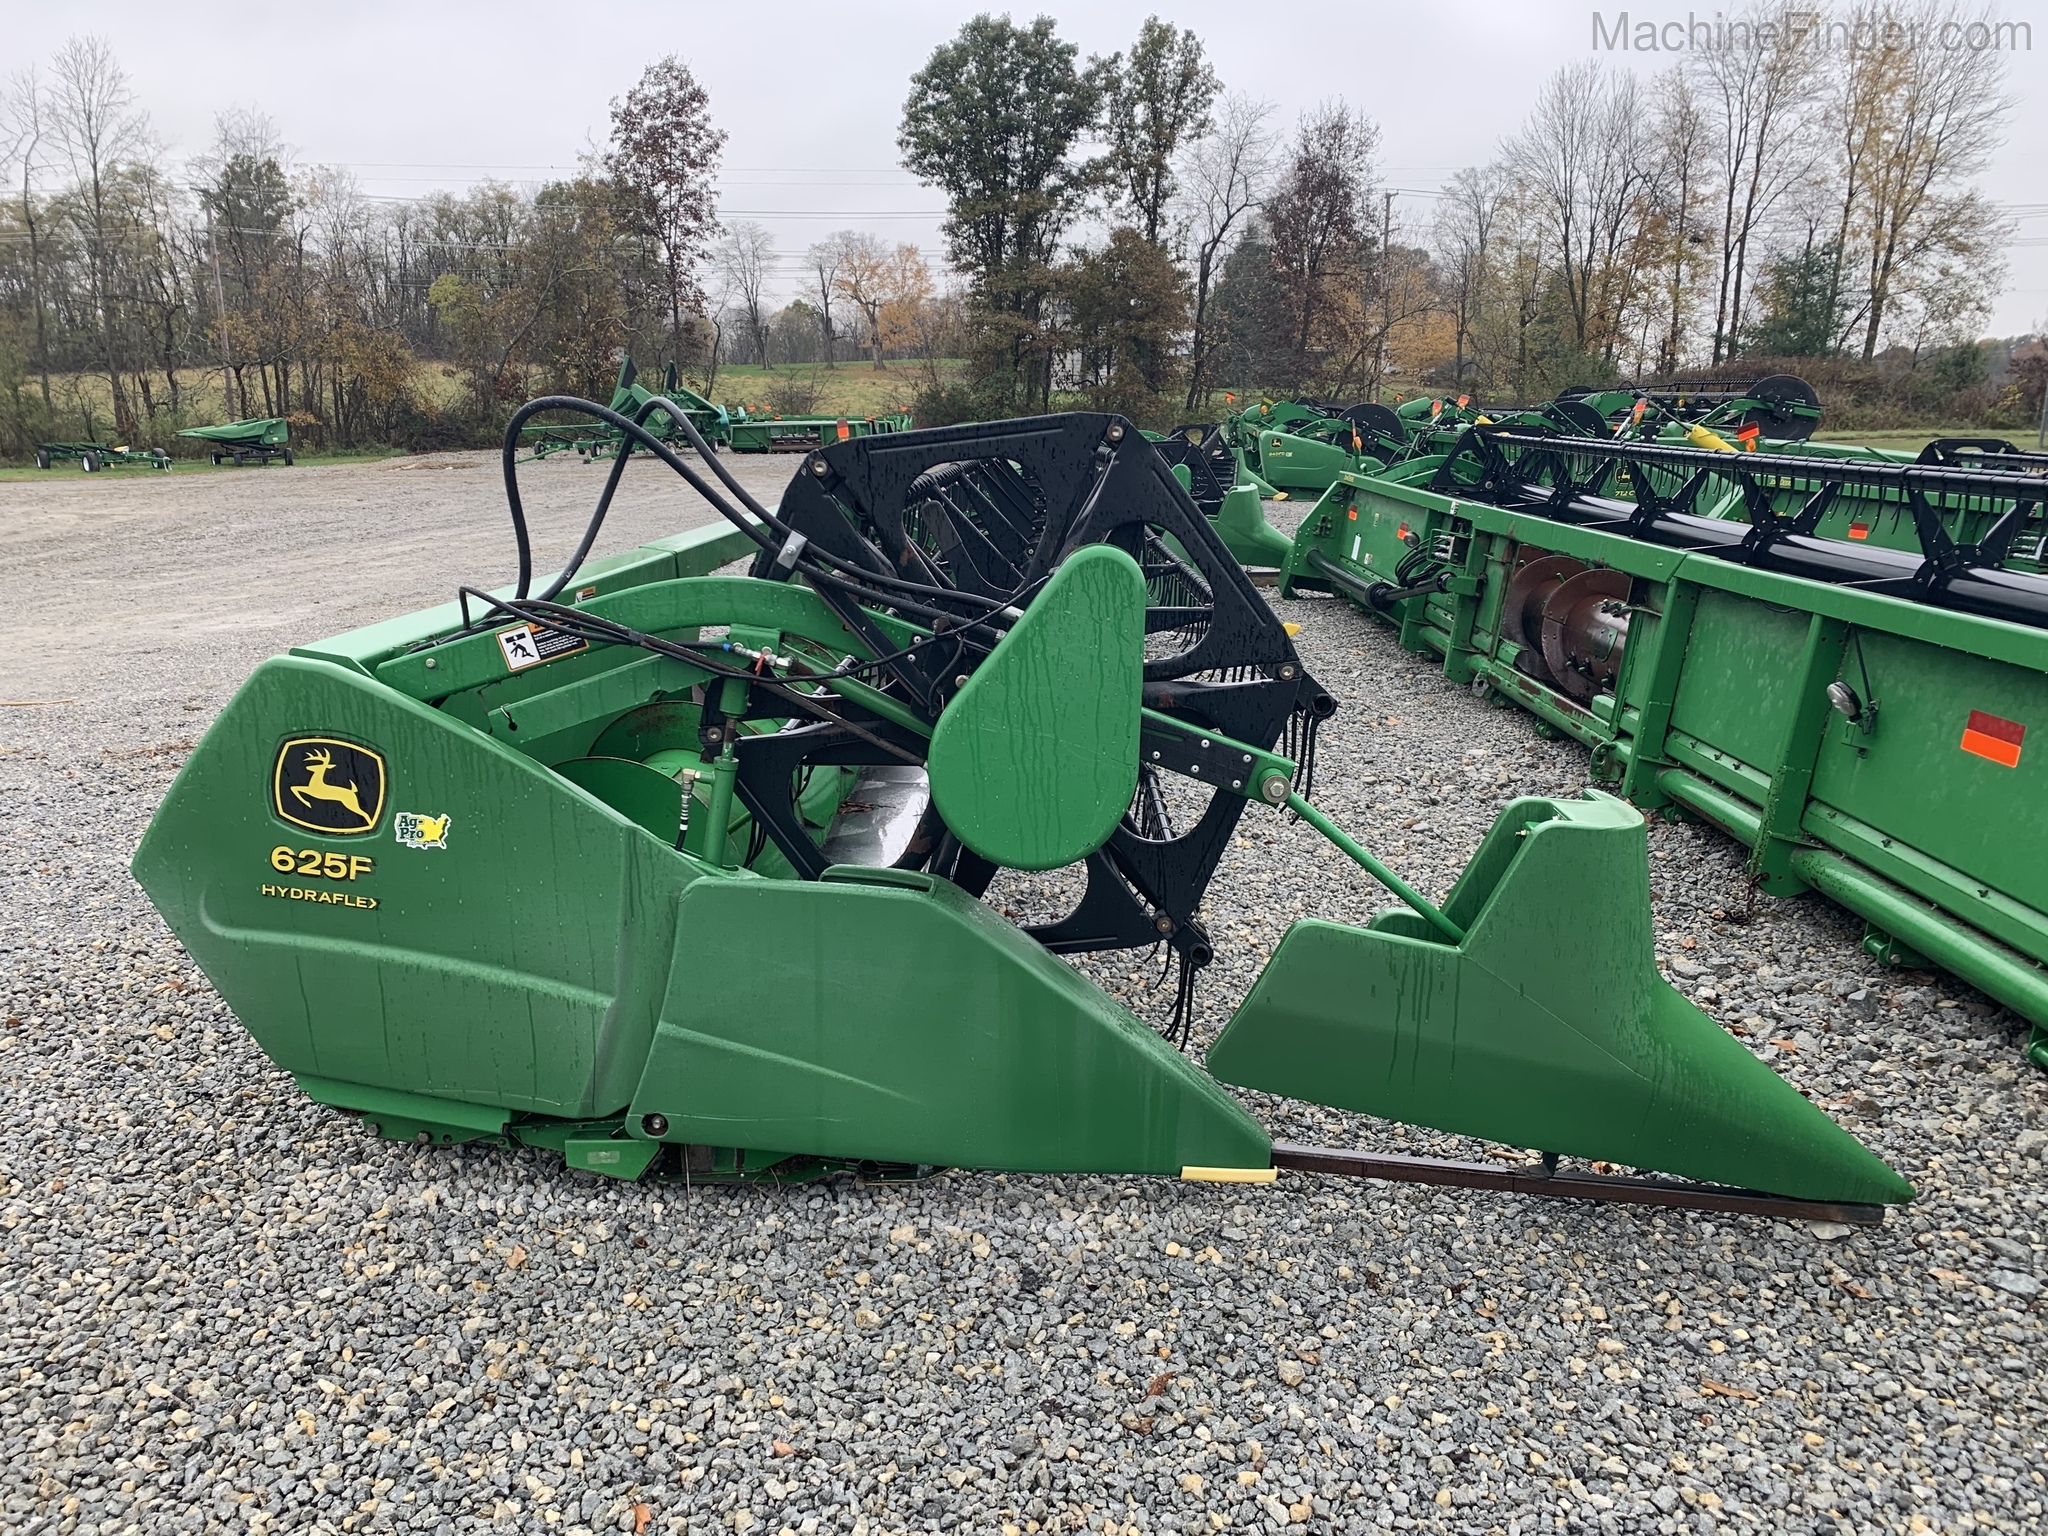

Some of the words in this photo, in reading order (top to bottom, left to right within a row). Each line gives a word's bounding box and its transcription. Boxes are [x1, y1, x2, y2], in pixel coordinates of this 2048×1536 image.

[398, 815, 423, 829] Ag-
[399, 827, 425, 839] Pro
[270, 845, 374, 881] 625F
